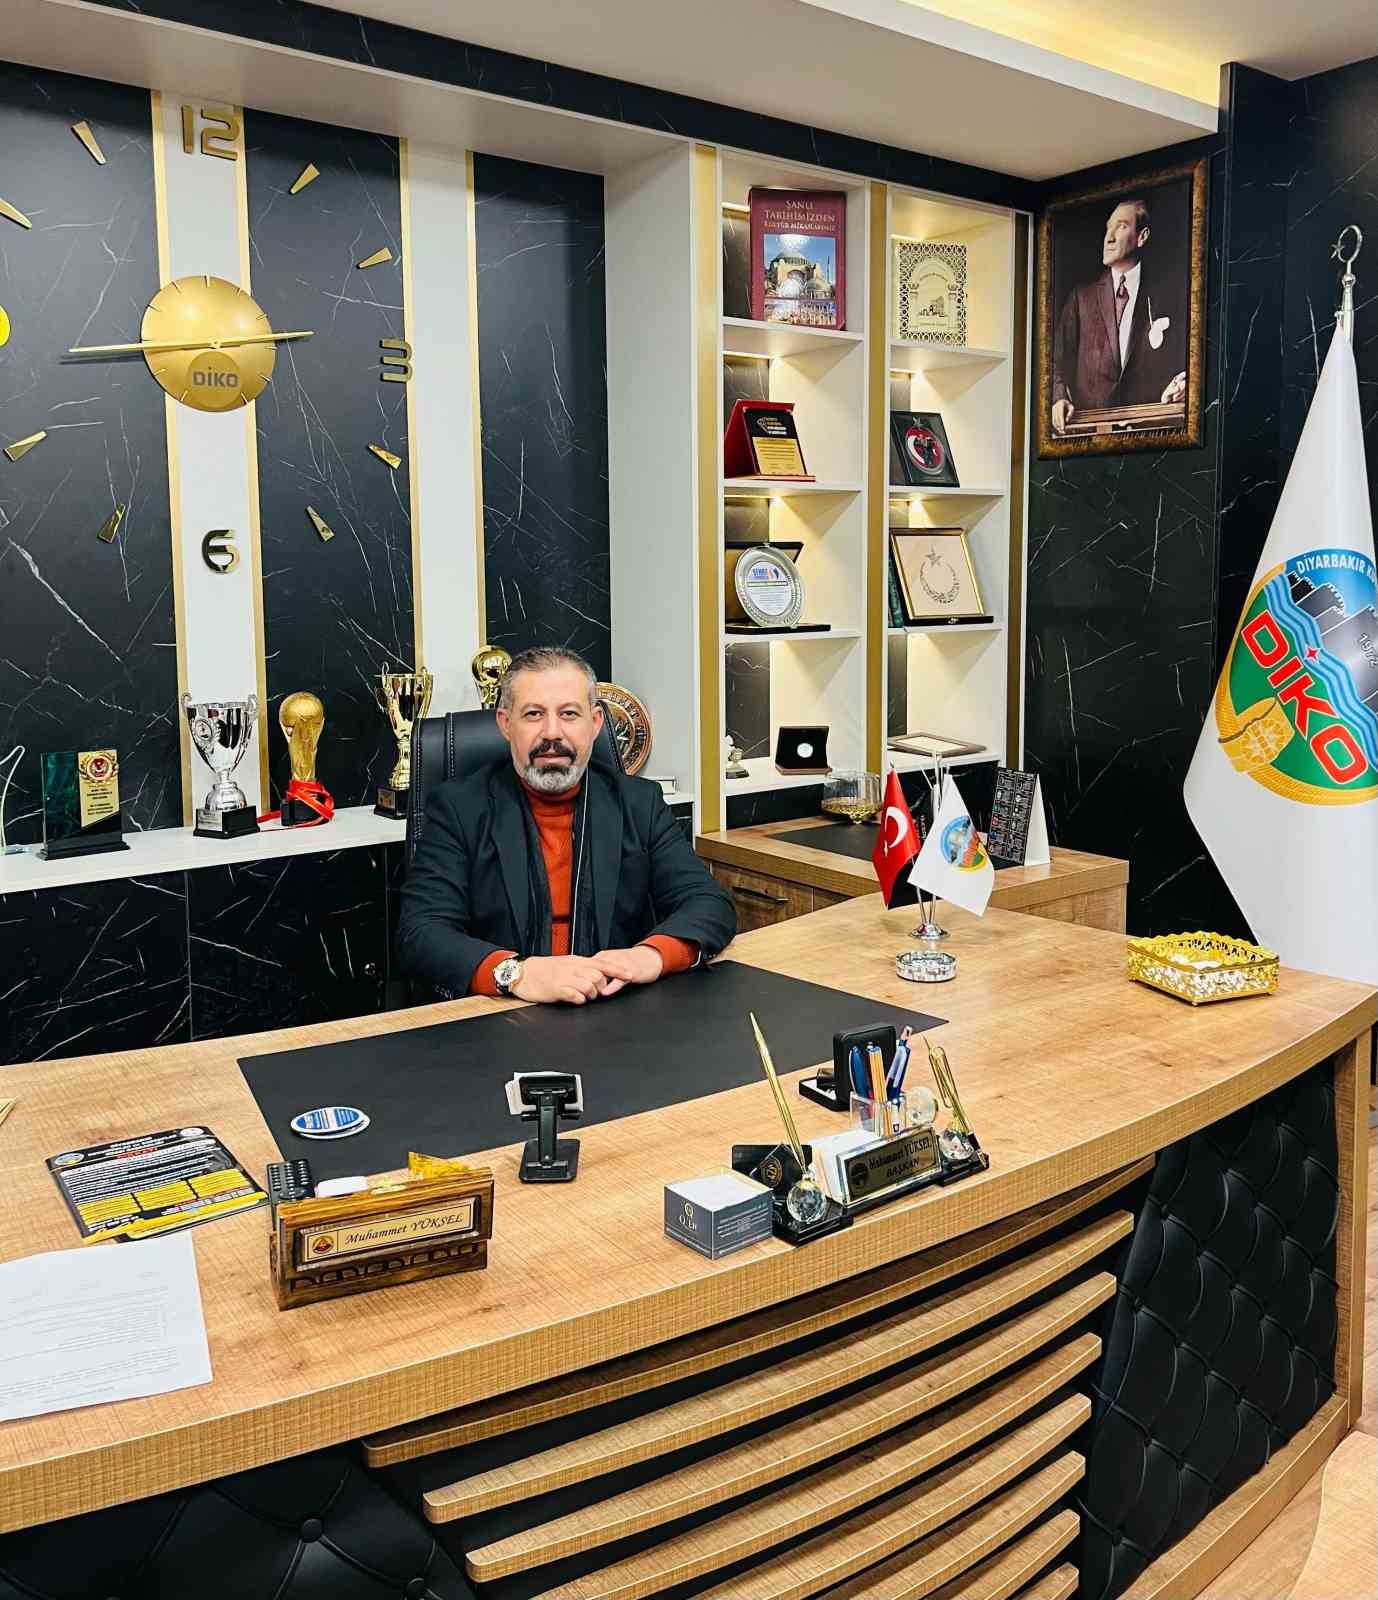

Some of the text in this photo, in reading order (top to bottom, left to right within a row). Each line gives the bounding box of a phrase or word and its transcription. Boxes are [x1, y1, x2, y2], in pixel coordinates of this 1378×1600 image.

[181, 103, 241, 161] 12
[379, 337, 413, 384] 3
[201, 529, 240, 574] 6
[1296, 554, 1366, 574] DİYARBAKIR
[345, 1213, 464, 1246] Muhammet YÜKSEL
